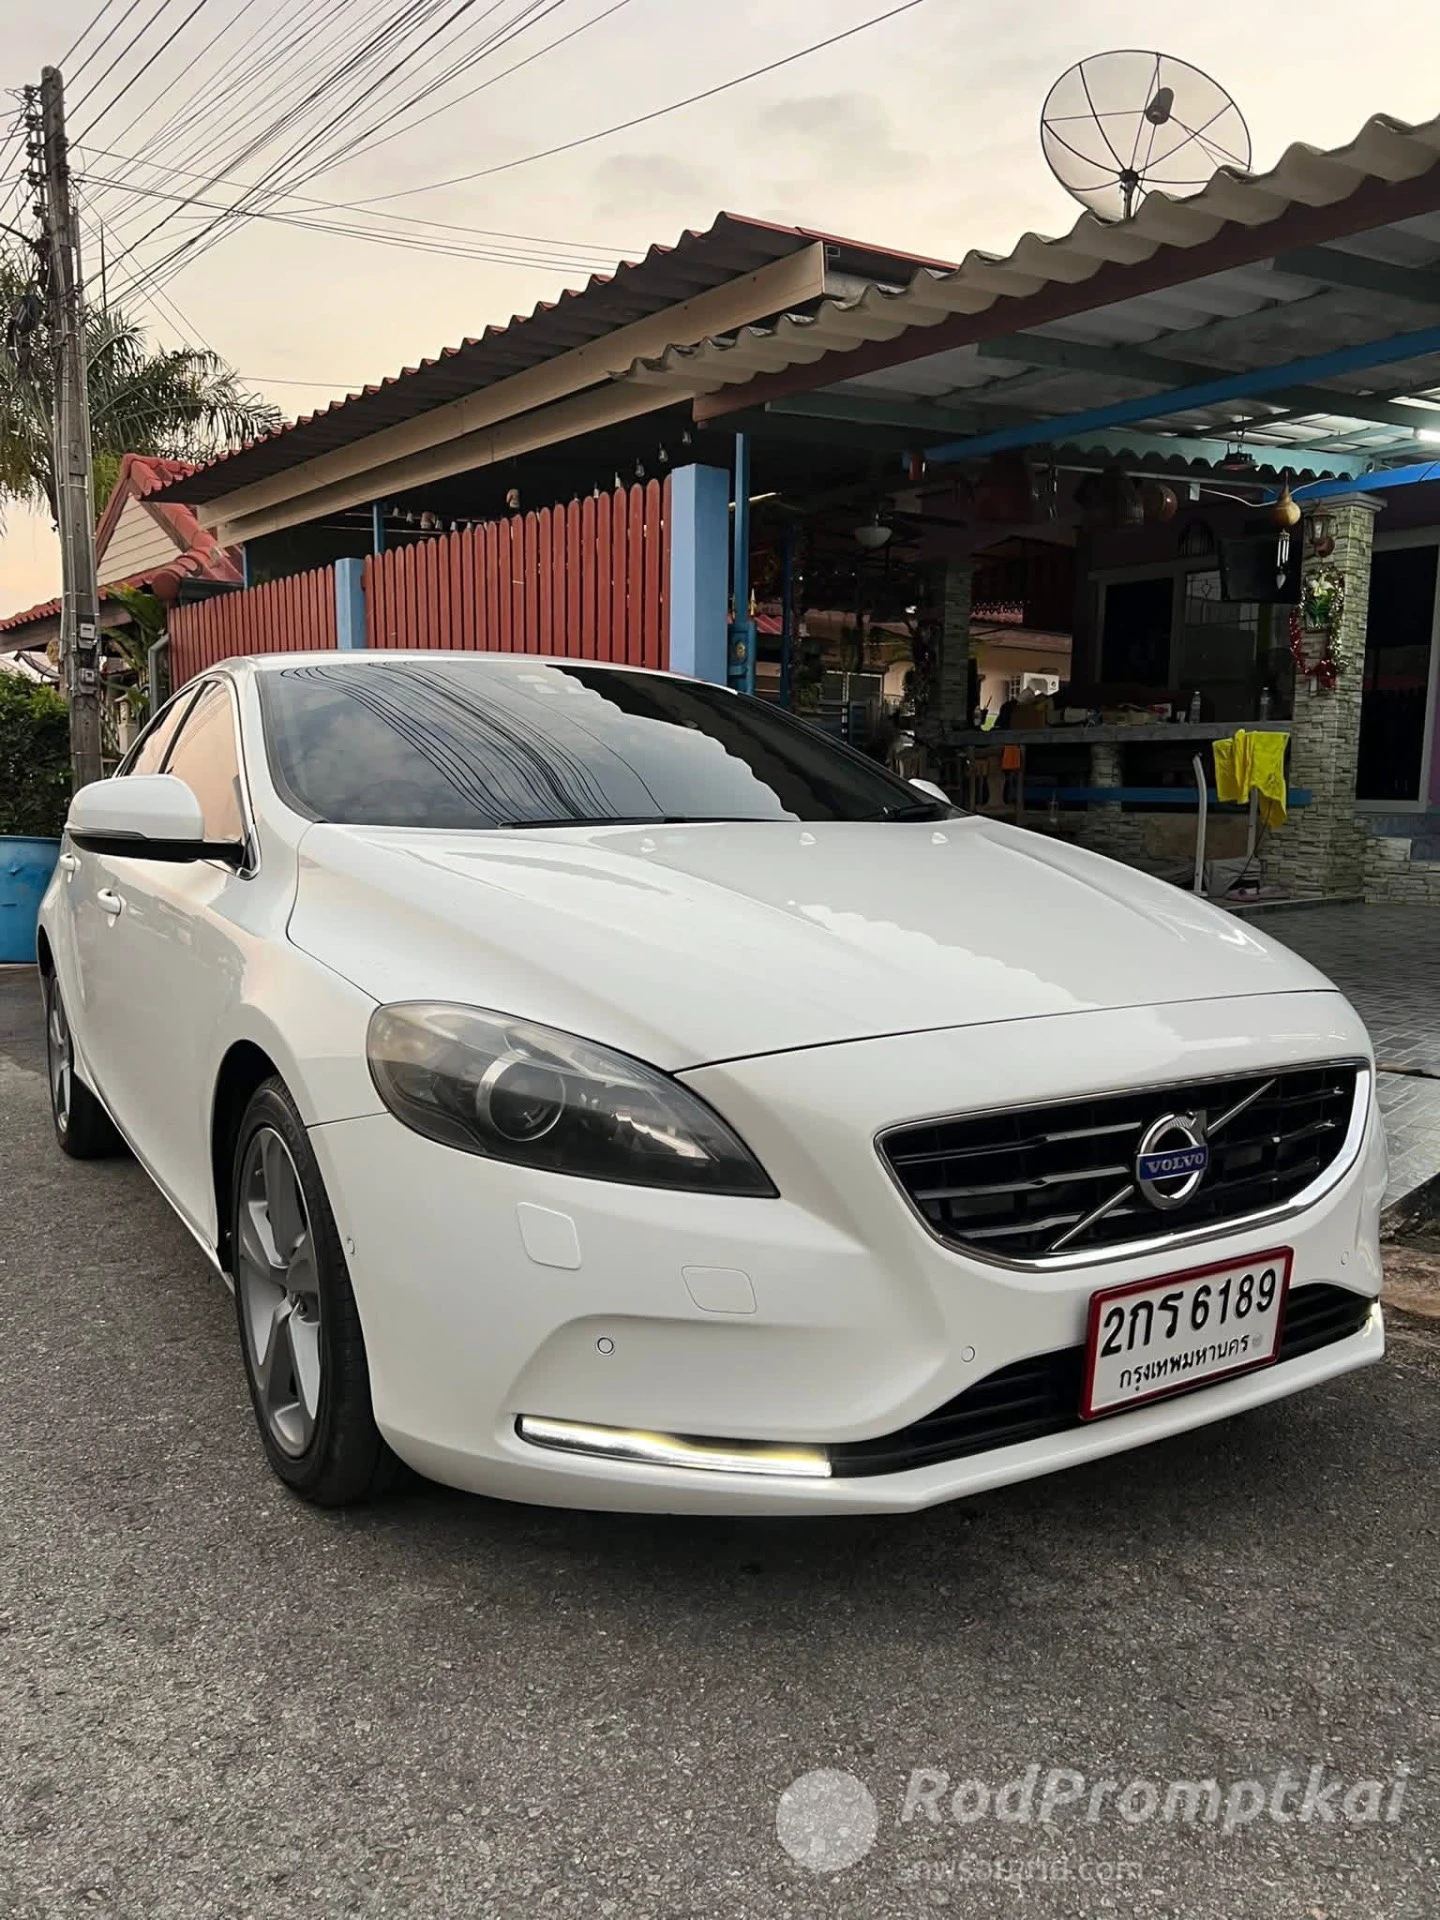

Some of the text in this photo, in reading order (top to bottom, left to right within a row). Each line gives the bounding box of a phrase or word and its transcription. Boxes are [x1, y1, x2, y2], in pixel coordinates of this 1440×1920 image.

[1146, 1153, 1204, 1173] VOLVO
[1101, 1268, 1276, 1358] 2กร 6189
[1119, 1334, 1250, 1391] กรุงเทพมหานคร
